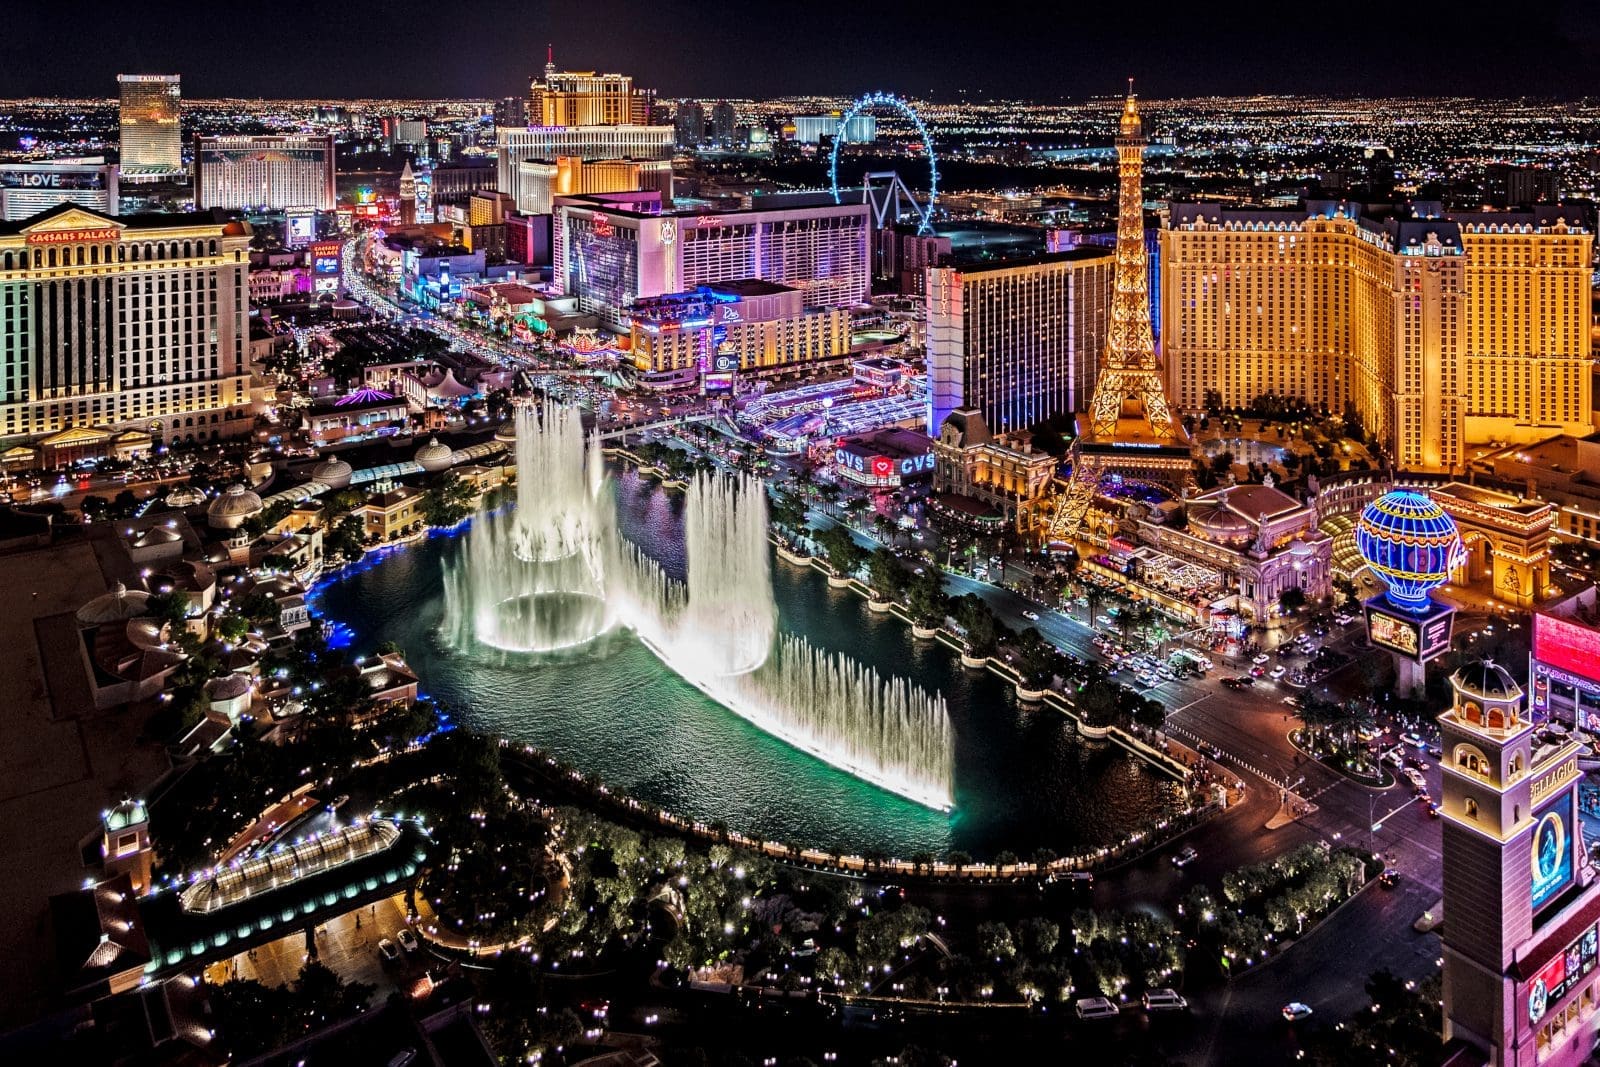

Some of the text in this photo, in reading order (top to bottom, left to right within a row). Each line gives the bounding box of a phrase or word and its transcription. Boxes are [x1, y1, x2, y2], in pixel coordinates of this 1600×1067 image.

[23, 174, 60, 187] LOVE
[29, 230, 117, 242] CAESARS PALACE
[835, 449, 864, 472] CVS
[901, 453, 935, 474] CVS
